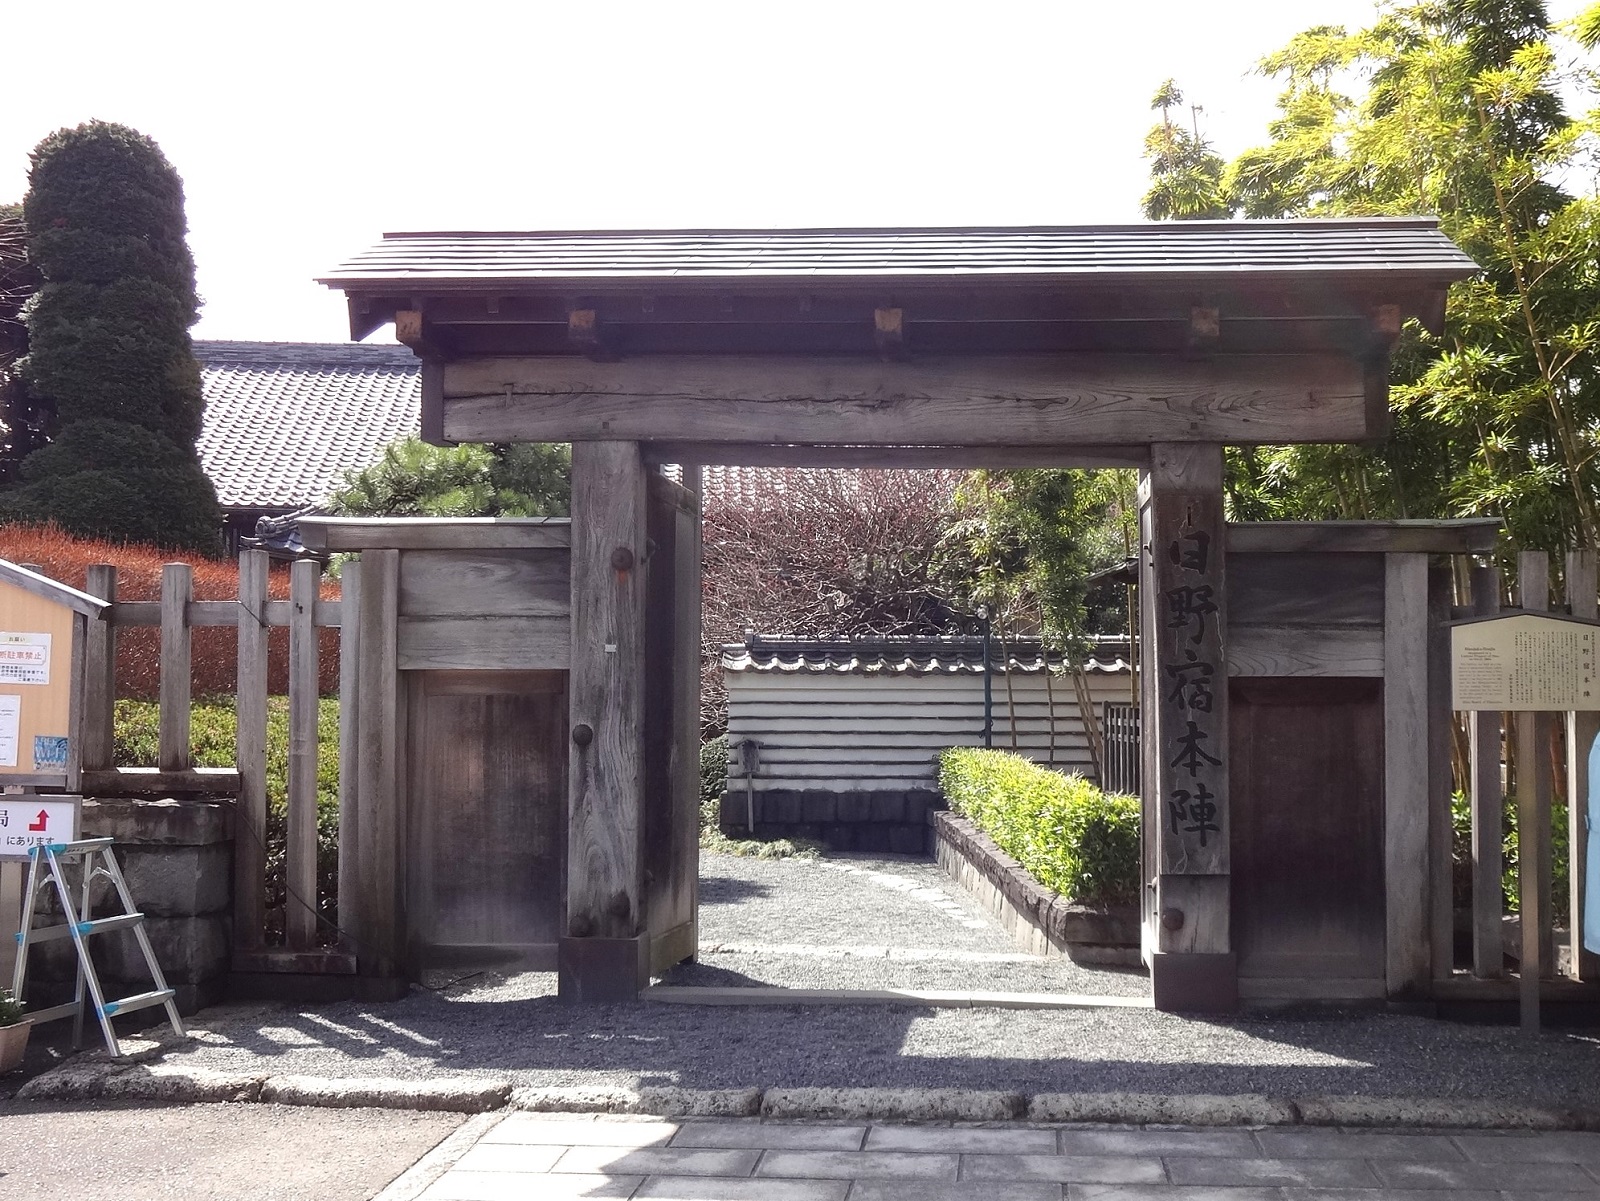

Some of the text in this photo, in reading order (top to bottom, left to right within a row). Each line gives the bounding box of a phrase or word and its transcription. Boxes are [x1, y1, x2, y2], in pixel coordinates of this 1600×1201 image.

[1166, 530, 1222, 847] 日野宿本陣
